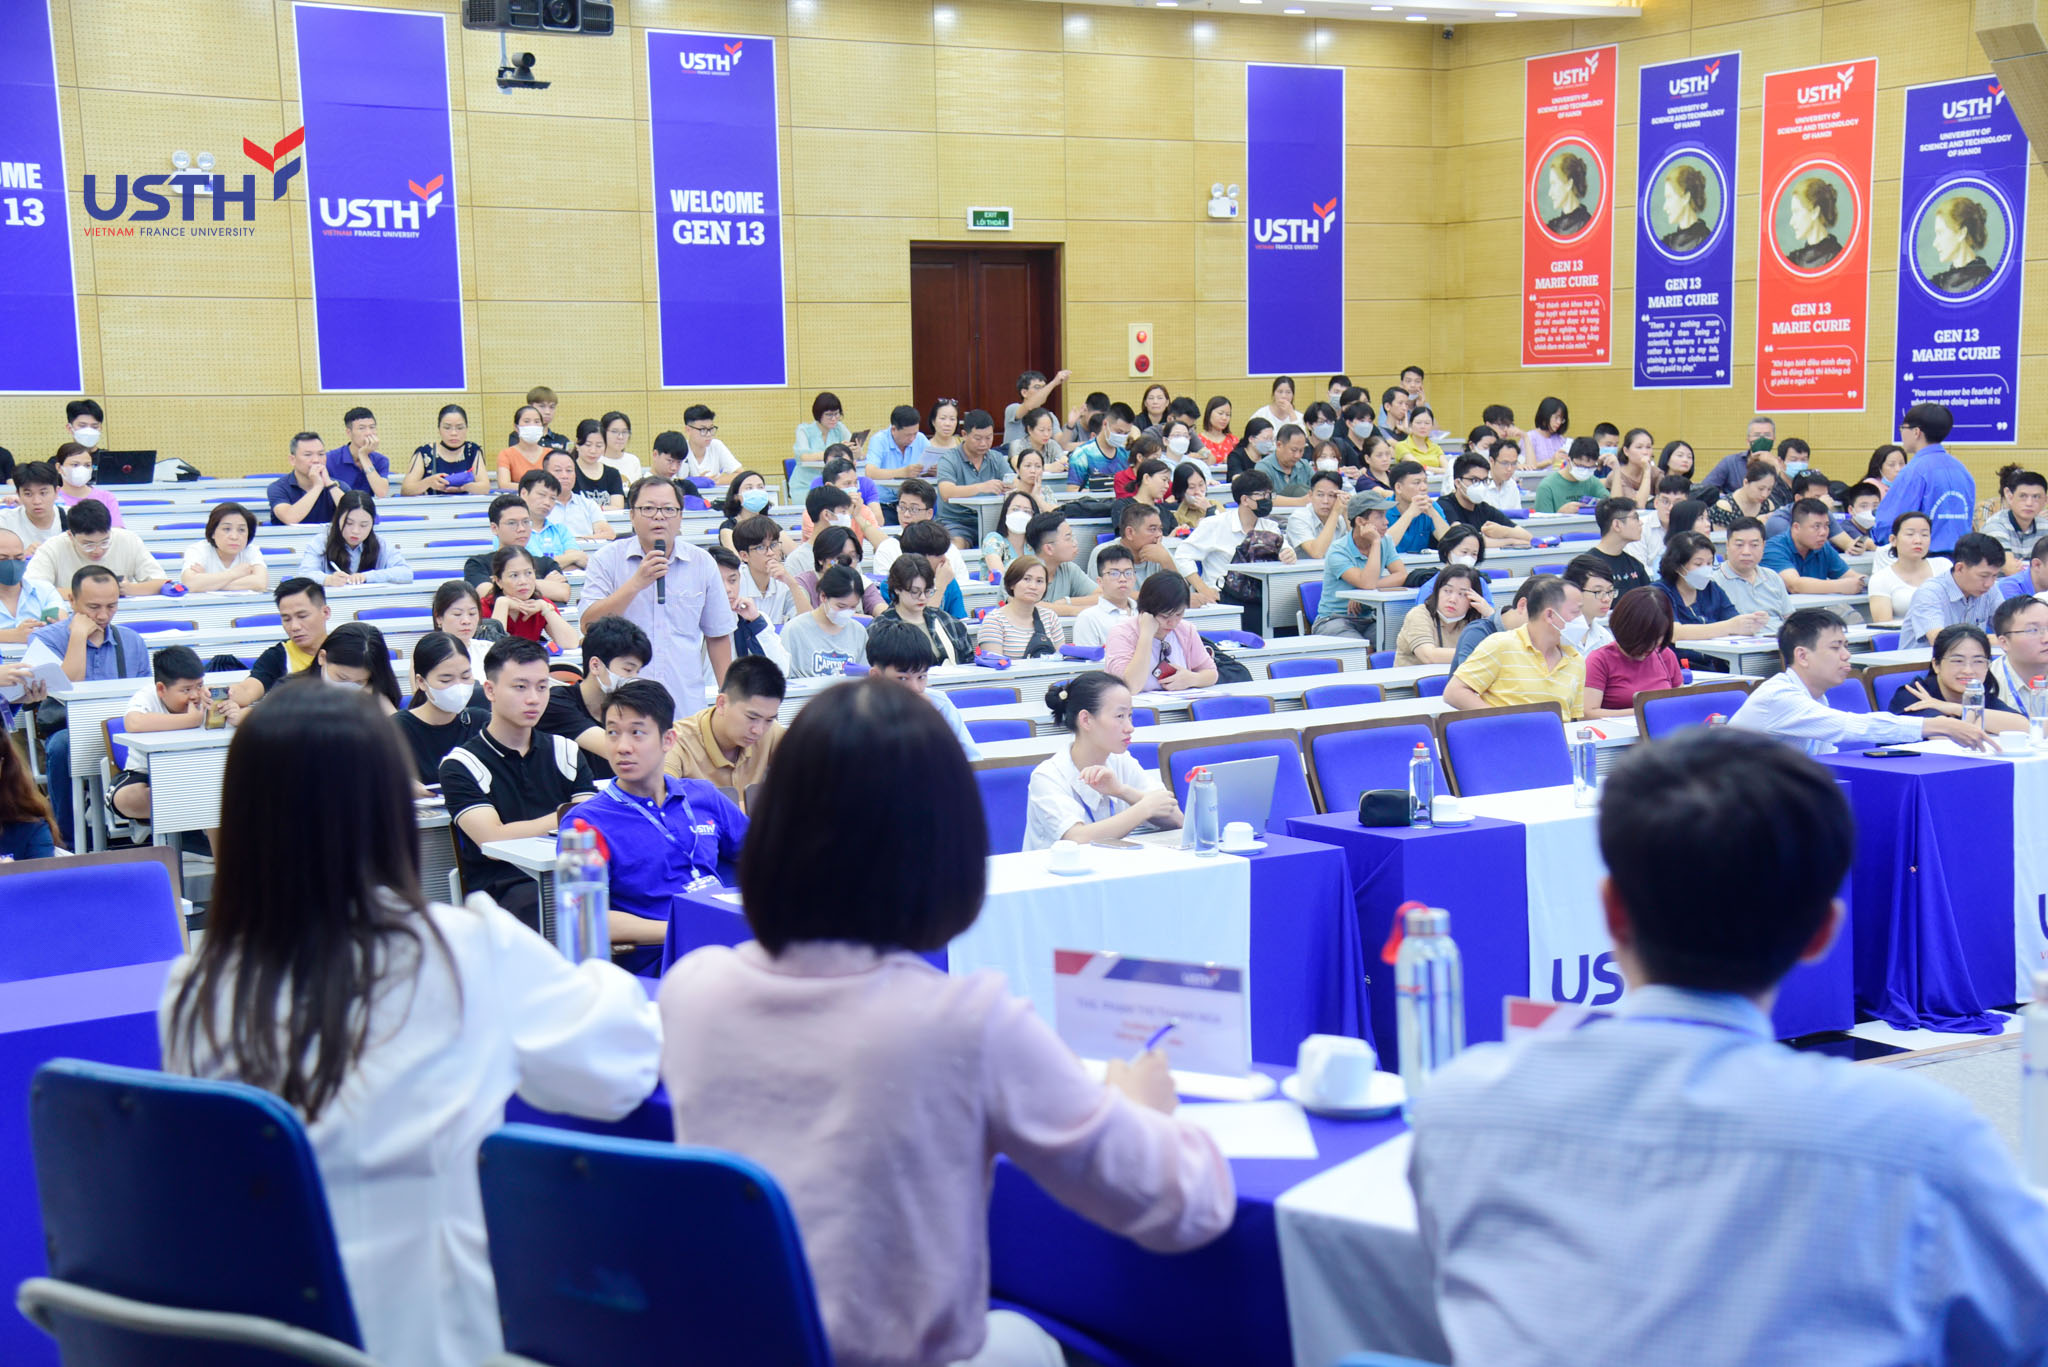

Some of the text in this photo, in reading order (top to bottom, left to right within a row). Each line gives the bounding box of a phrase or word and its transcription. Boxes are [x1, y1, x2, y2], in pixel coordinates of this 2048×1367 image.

[680, 52, 730, 71] USTH
[1553, 67, 1589, 86] USTH
[1669, 75, 1709, 95] USTH
[1797, 83, 1841, 104] USTH
[1942, 96, 1992, 119] USTH
[1920, 134, 2012, 152] SCIENCE AND TECHNOLOGY
[1940, 129, 1980, 140] UNIVERSITY
[1958, 147, 1981, 156] HANOI
[0, 162, 42, 189] ME
[670, 190, 765, 214] WELCOME
[4, 198, 46, 227] 13
[320, 198, 420, 230] USTH
[672, 220, 765, 246] GEN 13
[1254, 218, 1319, 243] USTH
[1551, 259, 1583, 272] GEN 13
[1536, 275, 1599, 289] MARIE CURIE
[1665, 277, 1701, 291] GEN 13
[1648, 293, 1719, 308] MARIE CURIE
[1792, 302, 1831, 316] GEN 13
[1772, 319, 1850, 334] MARIE CURIE
[1934, 328, 1979, 343] GEN 13
[1912, 346, 2001, 362] MARIE CURIE
[1951, 398, 1968, 407] doing
